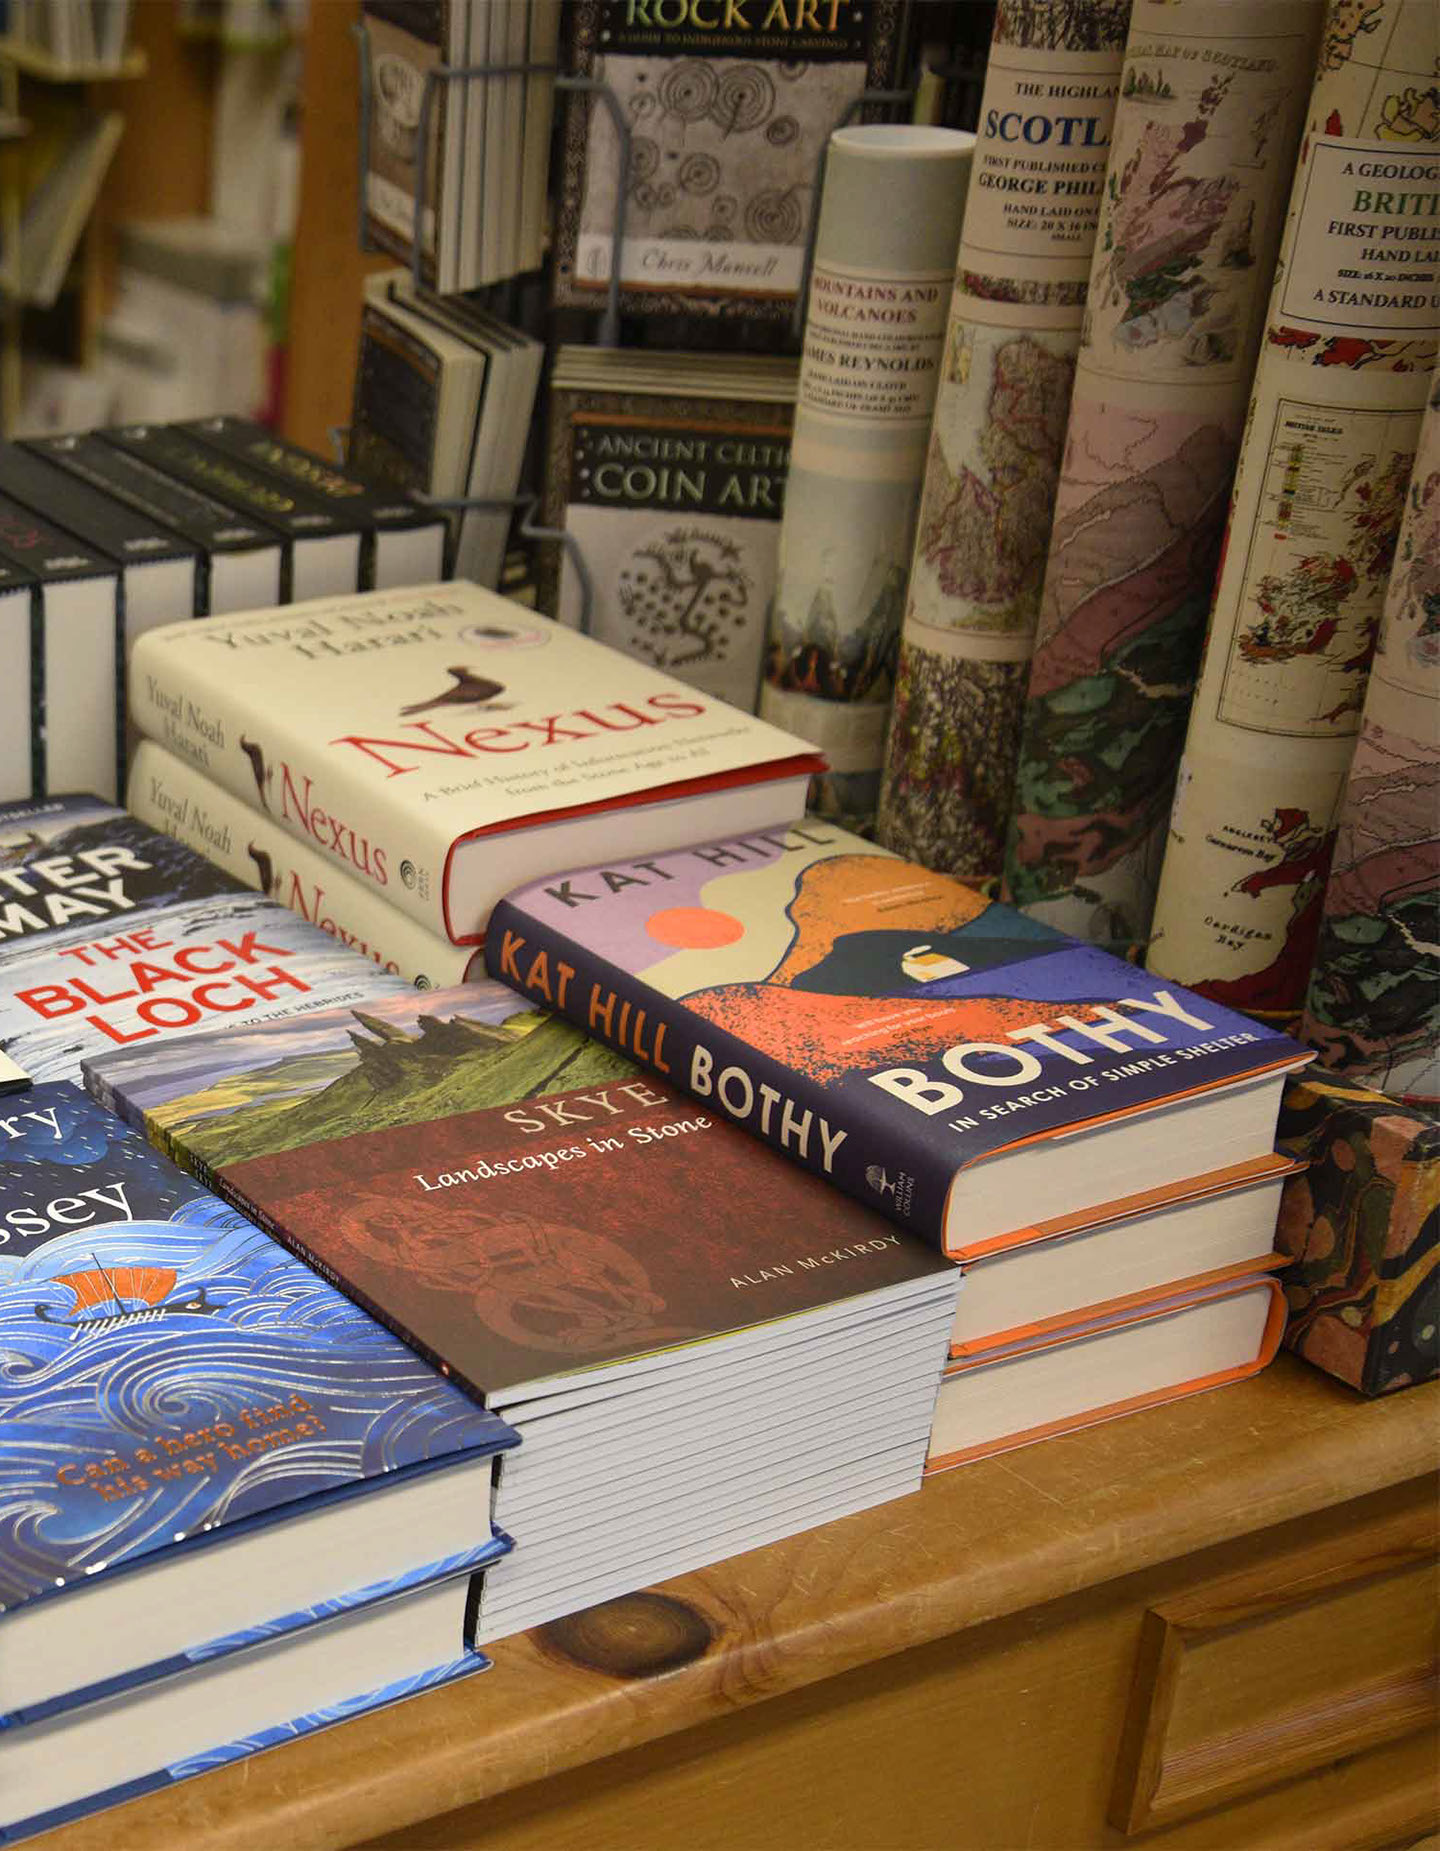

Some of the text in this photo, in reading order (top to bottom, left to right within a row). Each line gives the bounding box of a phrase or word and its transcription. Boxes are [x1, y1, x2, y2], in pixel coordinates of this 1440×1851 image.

[627, 0, 849, 31] ROCK ART
[1016, 82, 1044, 97] THE
[985, 109, 1112, 147] SCOTL
[979, 172, 1105, 196] GEORGE PHIL
[1012, 158, 1089, 174] PUBLISHED
[1342, 161, 1440, 180] A GEOLOG
[1004, 203, 1038, 215] HAND
[1041, 205, 1073, 217] LAID
[1328, 221, 1379, 240] FIRST
[1361, 248, 1410, 262] HAND
[817, 298, 917, 324] VOLCANOES
[901, 286, 939, 303] AND
[1314, 288, 1427, 308] A STANDARD
[840, 353, 936, 372] REYNOLDS
[598, 434, 706, 462] ANCIENT
[592, 463, 707, 501] COIN
[207, 619, 332, 649] Yuval
[341, 601, 466, 629] Noah
[296, 625, 443, 659] Harari
[147, 674, 225, 749] Yuval Noah
[328, 693, 708, 778] Nexus
[151, 776, 188, 826] Yuval
[193, 804, 232, 854] Noah
[281, 762, 389, 885] Nexus
[544, 829, 836, 909] KAT HILL
[58, 928, 173, 966] THE
[13, 930, 297, 1020] BLACK
[85, 966, 313, 1045] LOCH
[263, 1008, 295, 1021] THE
[296, 991, 366, 1014] HEBRIDES
[500, 929, 671, 1075] KAT HILL
[867, 990, 1215, 1116] BOTHY
[948, 1031, 1261, 1134] IN SEARCH OF SIMPLE SHELTER
[503, 1082, 670, 1134] SKYE
[690, 1043, 849, 1175] BOTHY
[414, 1115, 713, 1192] Landscapes in Stone
[729, 1235, 902, 1290] ALAN McKIRDY
[57, 1393, 313, 1486] Can a hero find
[90, 1413, 327, 1502] his way home?
